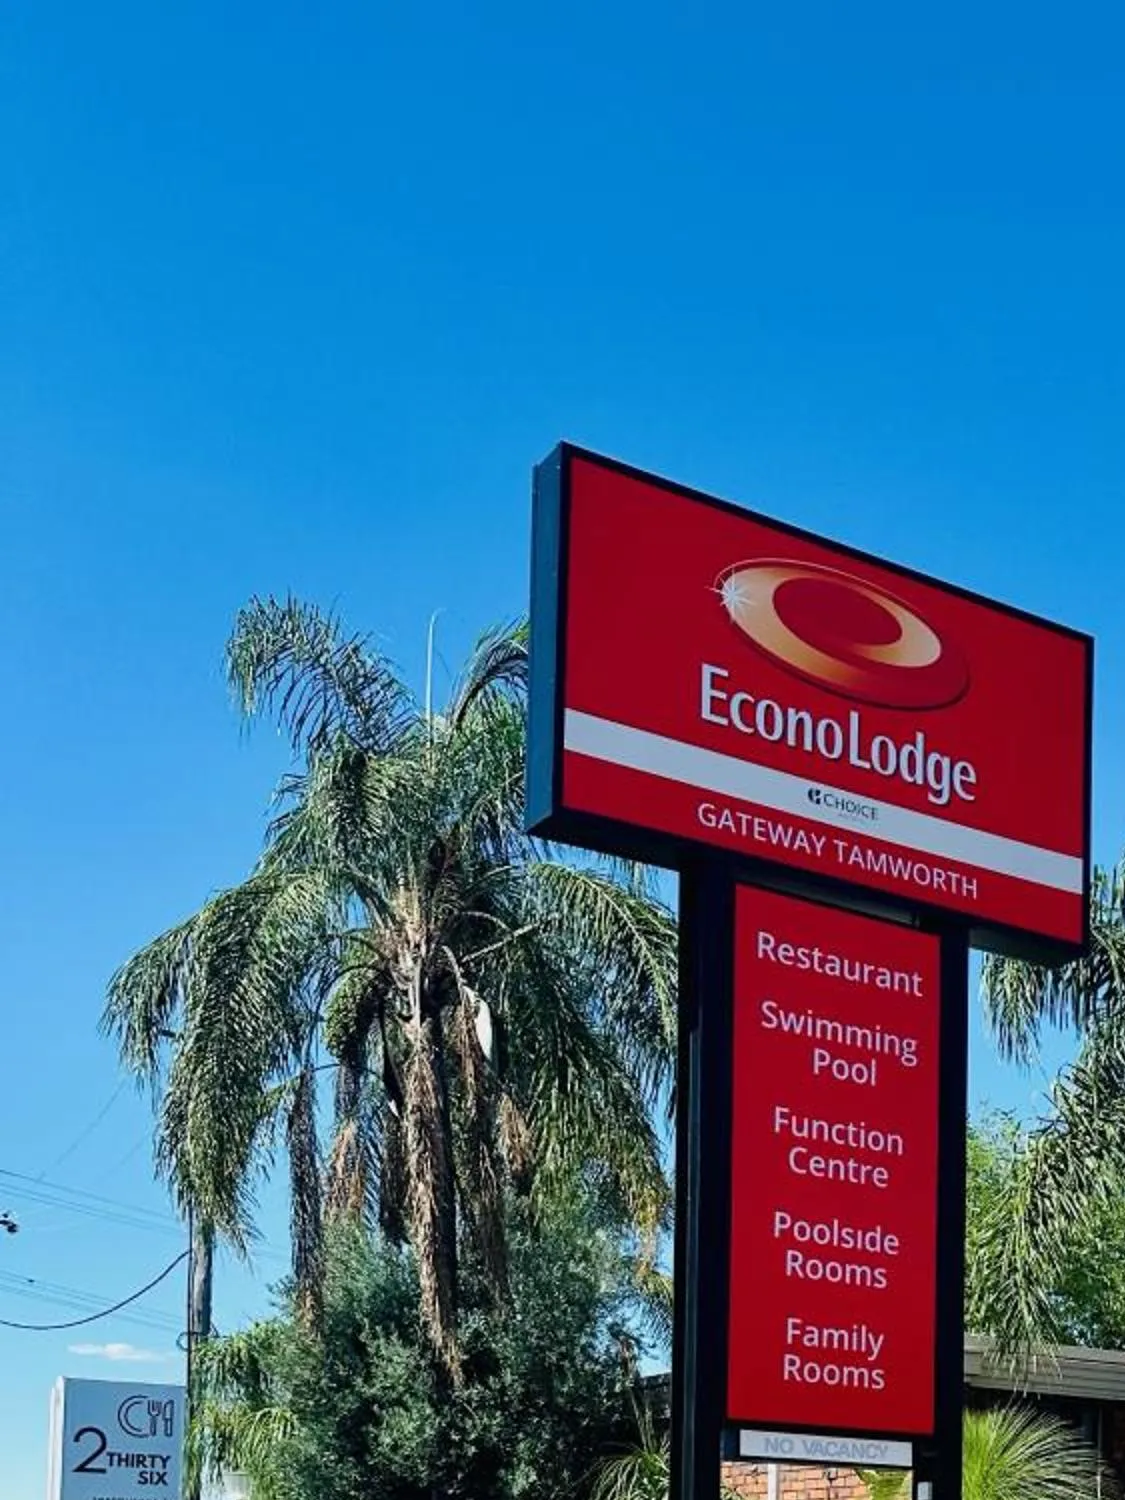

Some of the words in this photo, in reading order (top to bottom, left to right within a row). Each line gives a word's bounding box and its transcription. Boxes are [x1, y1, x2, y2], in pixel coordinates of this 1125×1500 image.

[700, 662, 977, 803] EconoLodge
[823, 793, 879, 820] CHOICE
[697, 803, 826, 857] GATEWAY
[833, 840, 978, 899] TAMWORTH
[756, 931, 924, 997] Restaurant
[760, 1000, 918, 1066] Swimming
[812, 1048, 877, 1086] Pool
[773, 1106, 904, 1155] Function
[788, 1146, 889, 1187] Centre
[773, 1212, 900, 1255] Poolside
[785, 1251, 887, 1288] Rooms
[786, 1318, 885, 1361] Family
[783, 1354, 885, 1389] Rooms
[73, 1427, 107, 1474] 2
[106, 1452, 171, 1469] THIRTY
[764, 1437, 794, 1453] NO
[801, 1439, 889, 1460] VACANCY
[138, 1470, 168, 1486] SIX
